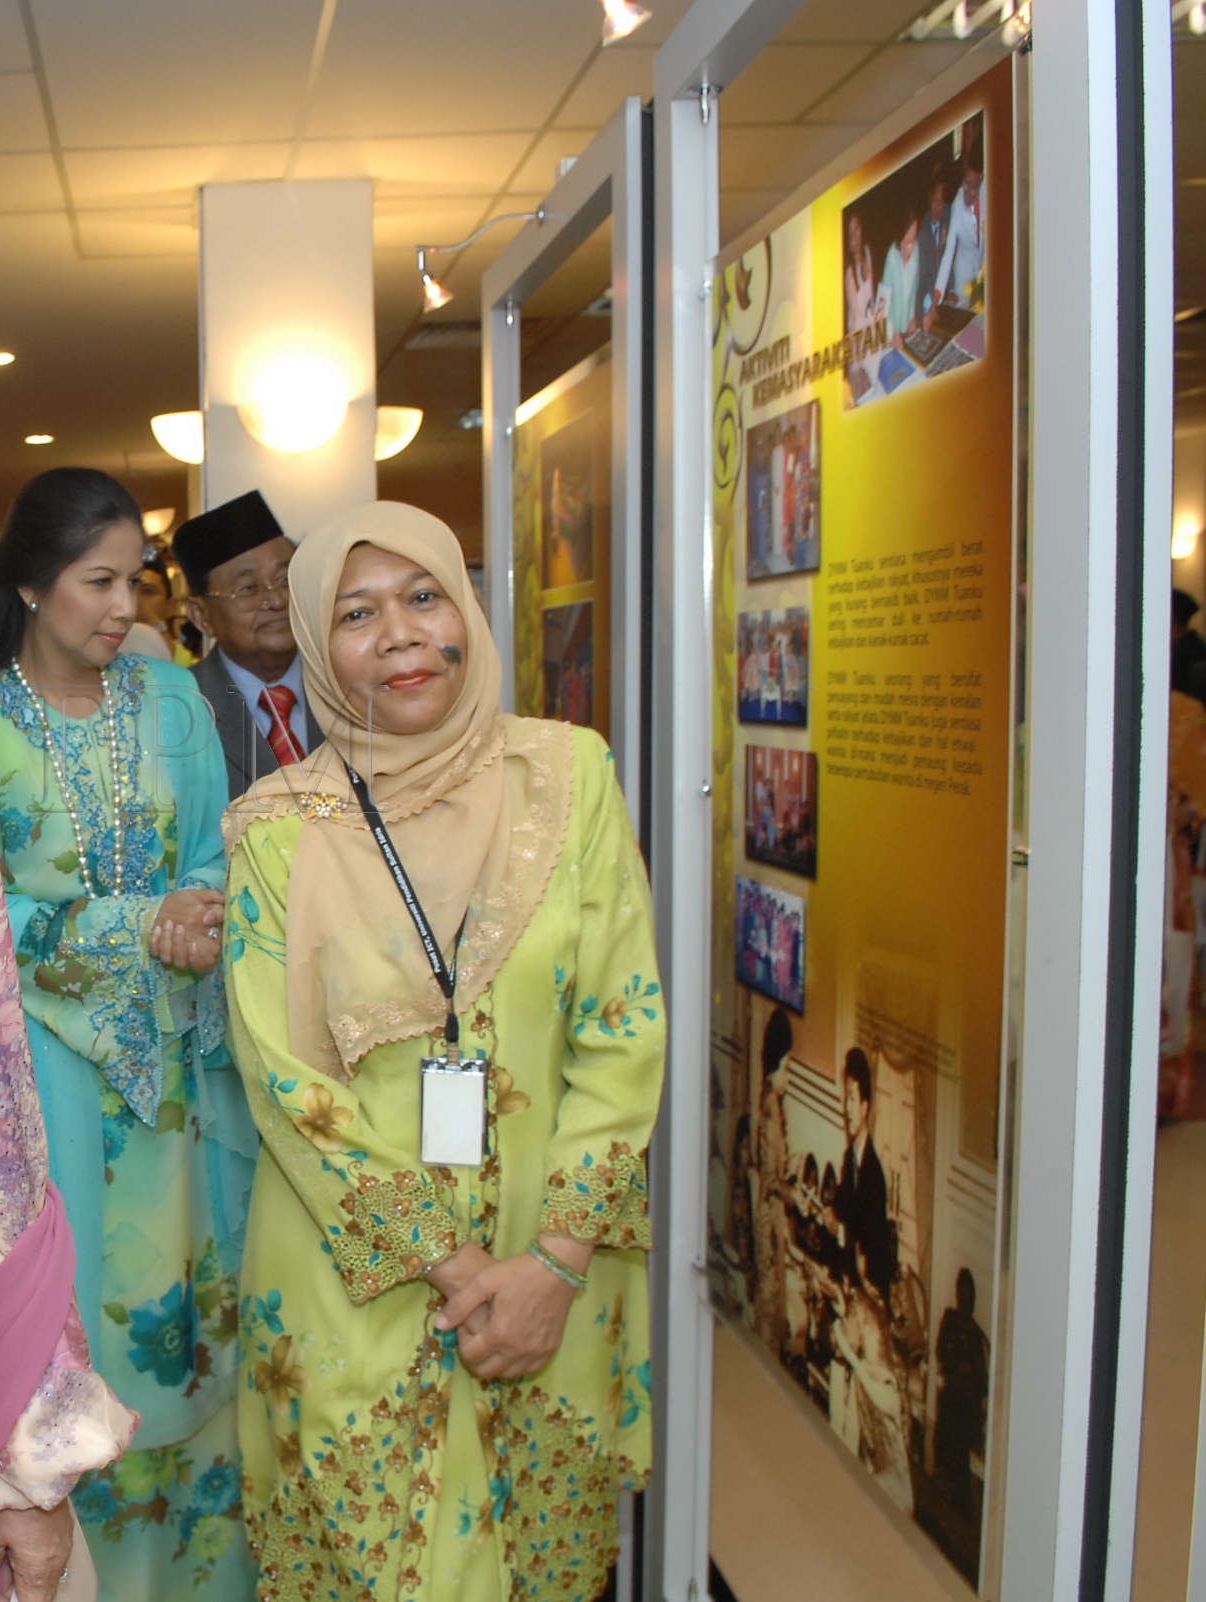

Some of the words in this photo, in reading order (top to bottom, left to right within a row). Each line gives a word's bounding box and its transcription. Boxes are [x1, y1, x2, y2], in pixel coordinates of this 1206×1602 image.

[739, 334, 790, 386] AKTIVITI
[374, 827, 386, 844] Idris
[383, 844, 397, 866] Sultan
[394, 866, 412, 903] Pendidikan
[410, 902, 427, 936] Universiti
[424, 936, 434, 952] ICT,
[429, 952, 442, 973] Pusat
